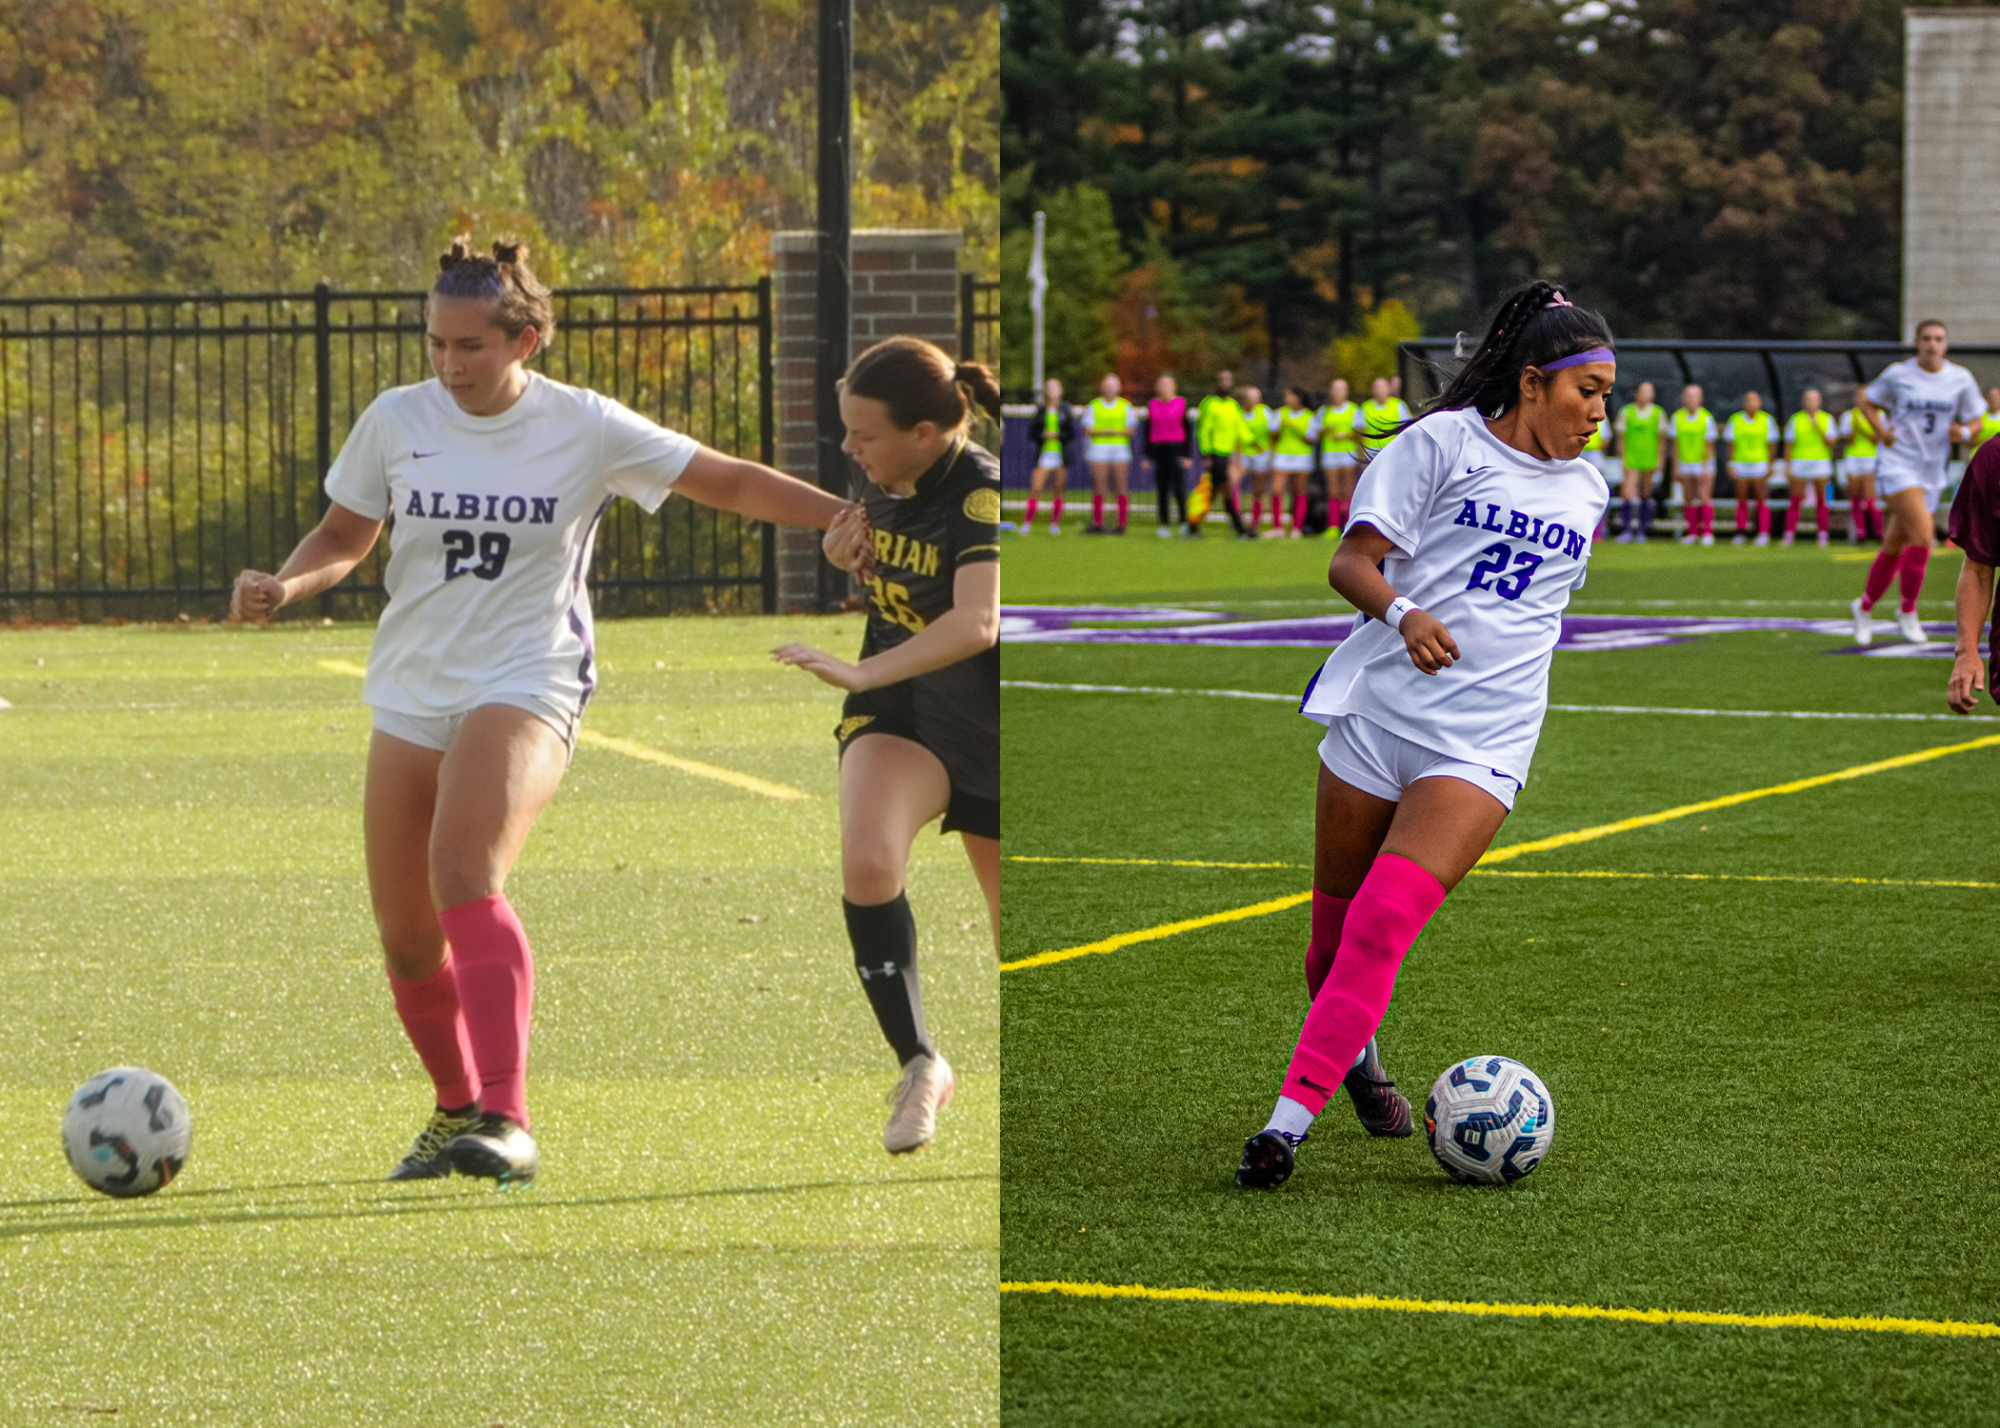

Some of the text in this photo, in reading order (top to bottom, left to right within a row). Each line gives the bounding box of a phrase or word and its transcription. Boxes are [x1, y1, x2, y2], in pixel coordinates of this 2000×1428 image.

[1923, 413, 1935, 434] 3
[405, 490, 559, 524] ALBION
[1453, 498, 1587, 561] ALBION
[442, 529, 511, 581] 29
[867, 528, 938, 577] RIAN
[1465, 542, 1544, 601] 23
